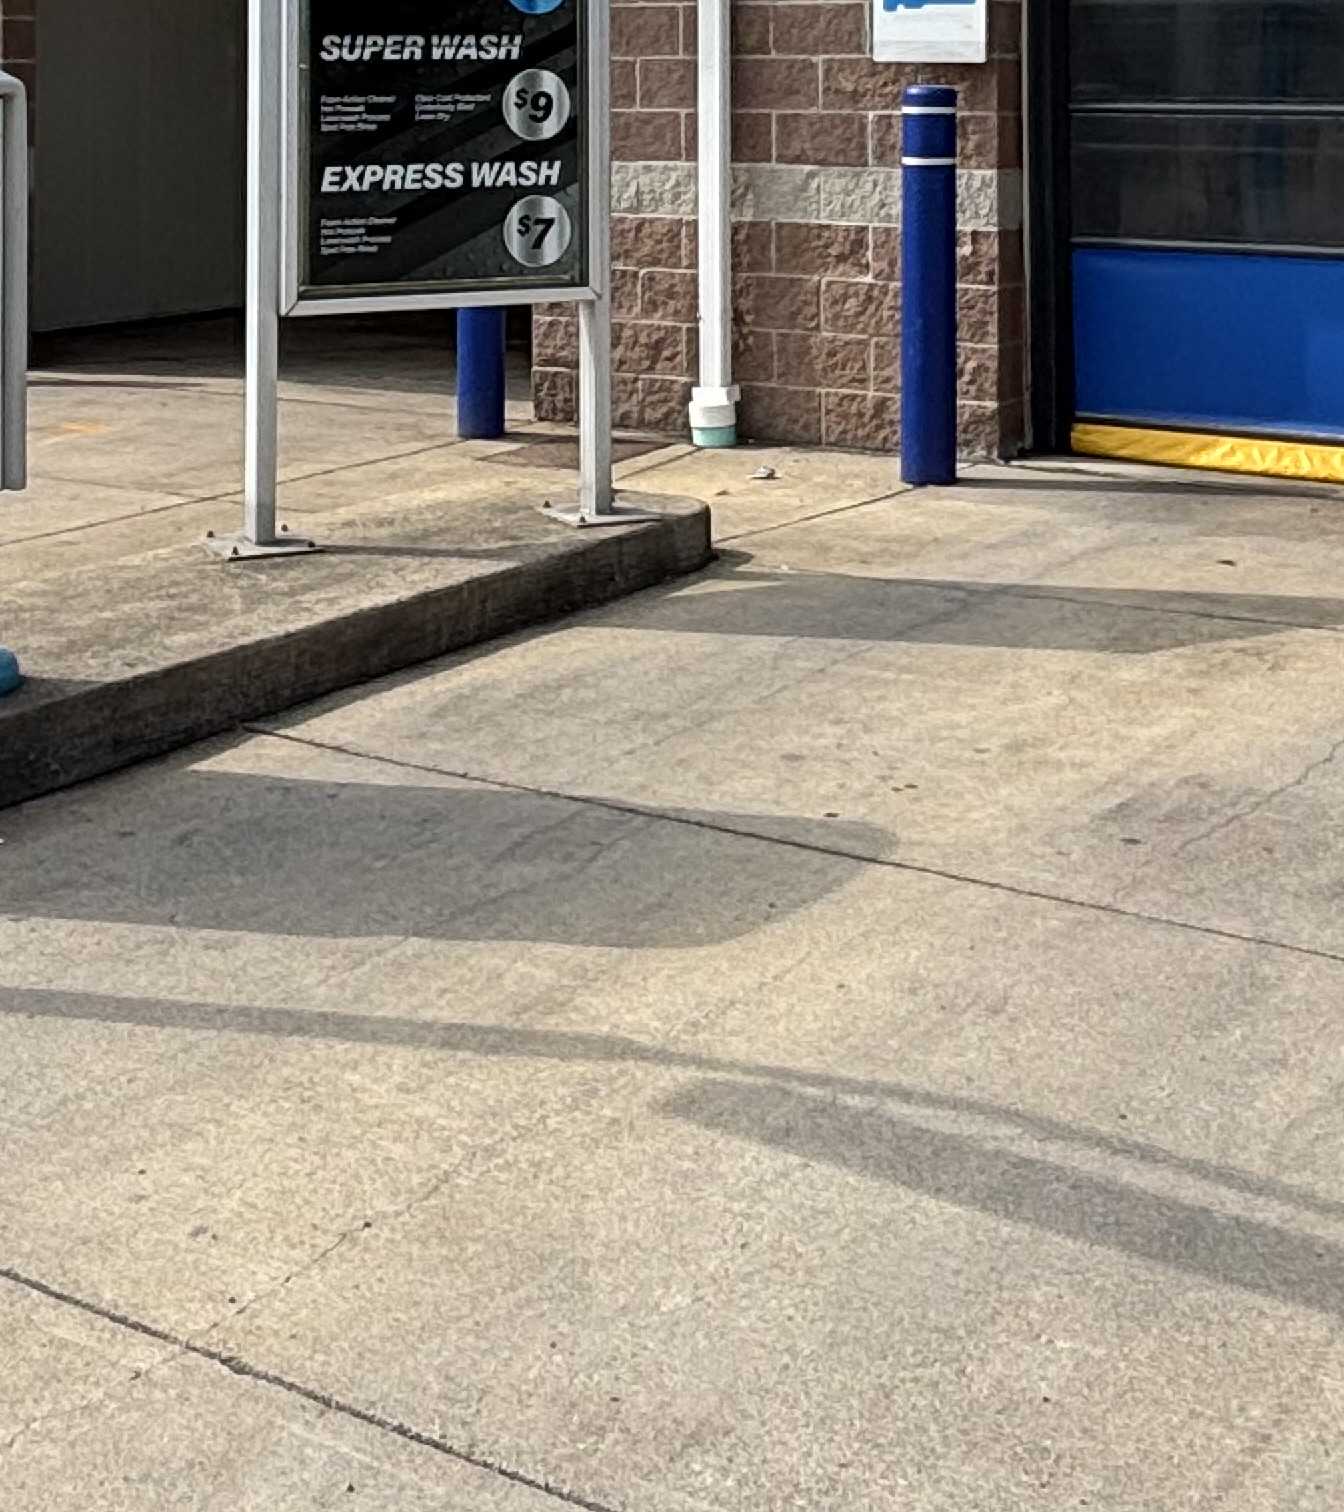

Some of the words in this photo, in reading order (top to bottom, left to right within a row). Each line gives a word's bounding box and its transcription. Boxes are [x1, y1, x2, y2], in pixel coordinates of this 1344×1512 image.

[319, 34, 426, 61] SUPER
[431, 34, 524, 60] WASH
[514, 88, 554, 124] $9
[320, 163, 465, 193] EXPRESS
[470, 160, 562, 188] WASH
[517, 215, 556, 250] $7
